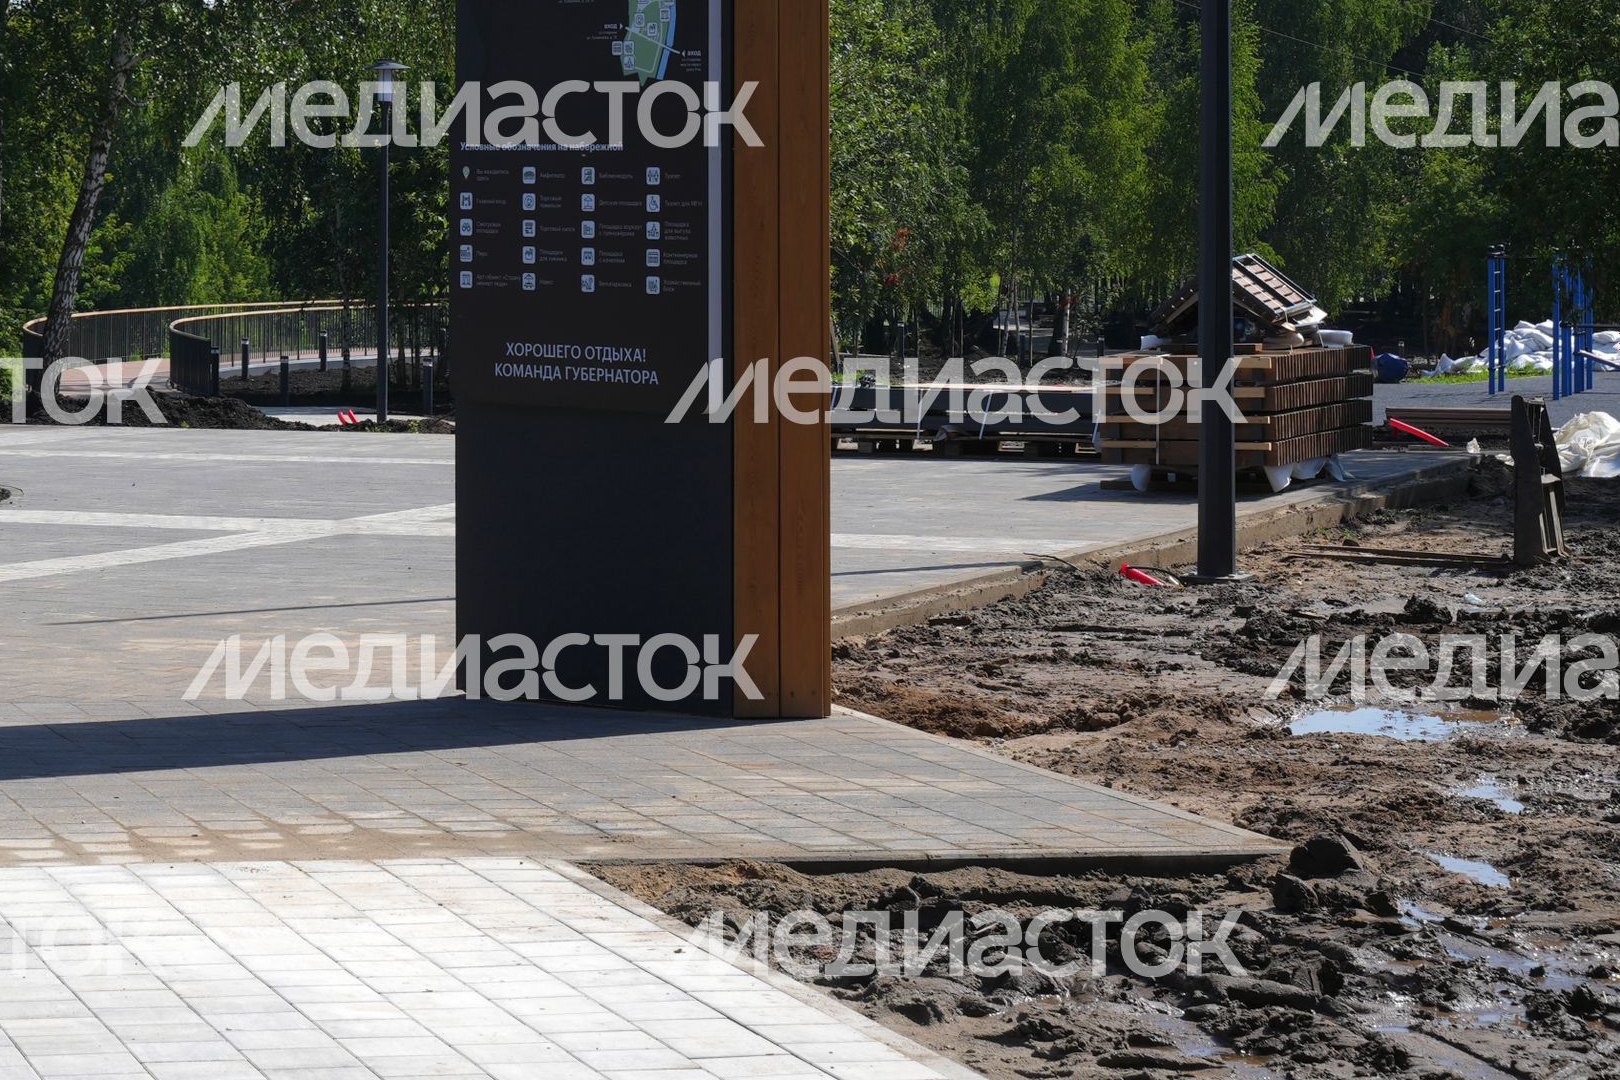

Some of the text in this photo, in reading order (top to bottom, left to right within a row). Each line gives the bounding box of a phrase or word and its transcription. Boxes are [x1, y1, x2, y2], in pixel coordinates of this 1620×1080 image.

[506, 342, 647, 363] ХОРОШЕГО ОТДЫХА!
[494, 363, 659, 385] КОМАНДА ГУБЕРНАТОРА
